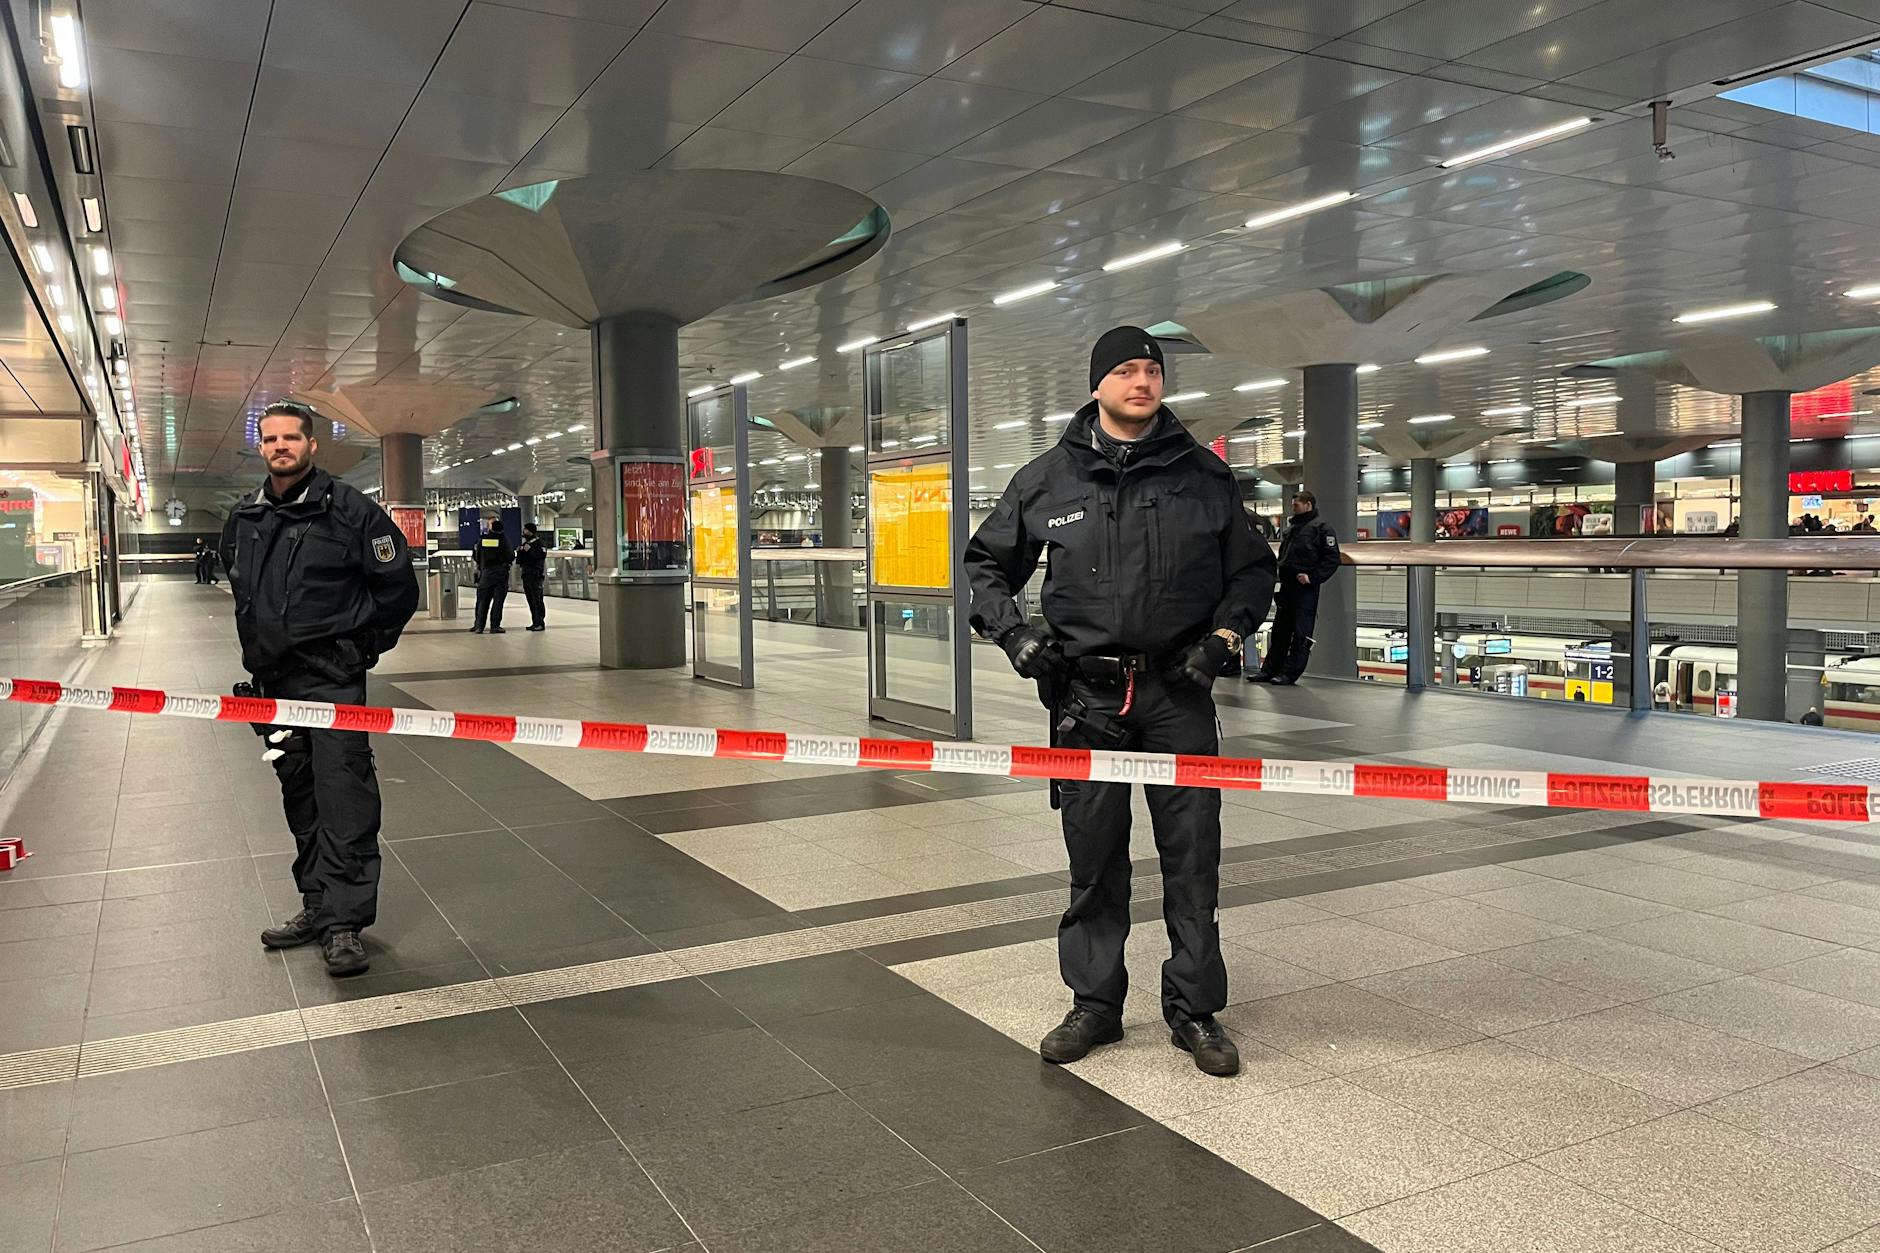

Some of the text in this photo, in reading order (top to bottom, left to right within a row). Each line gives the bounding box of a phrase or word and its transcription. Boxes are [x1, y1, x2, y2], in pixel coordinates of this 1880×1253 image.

[1048, 511, 1084, 528] POLIZEI
[1474, 667, 1481, 679] 3
[1594, 665, 1613, 679] 1-2
